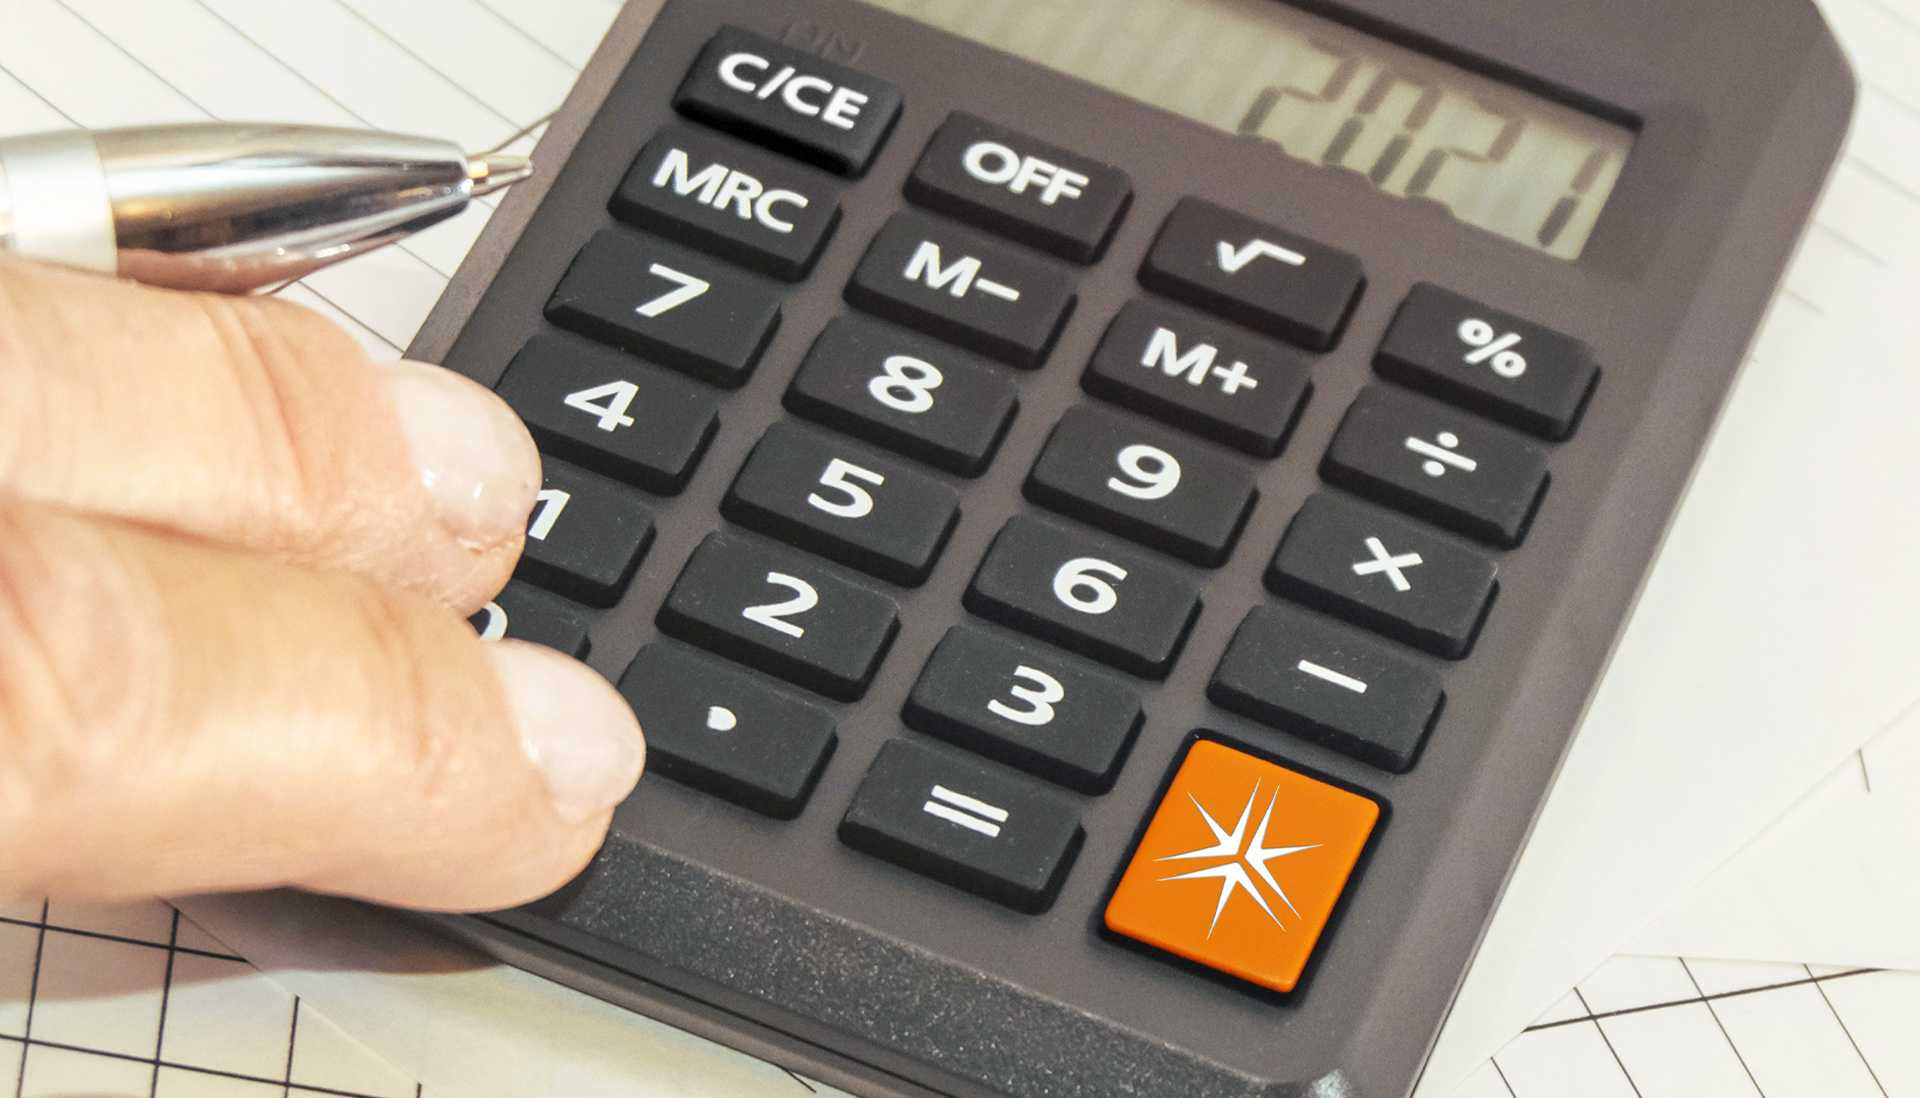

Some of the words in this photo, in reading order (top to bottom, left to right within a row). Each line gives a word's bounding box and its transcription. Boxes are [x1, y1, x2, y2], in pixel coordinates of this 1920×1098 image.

[717, 52, 869, 131] C/CE
[962, 141, 1089, 205] OFF
[1238, 36, 1606, 249] 2021
[651, 148, 809, 233] MRC
[635, 263, 711, 317] 7
[1139, 326, 1258, 395] M+
[1457, 317, 1528, 379] %
[563, 379, 640, 433] 4
[866, 354, 944, 414] 8
[807, 457, 885, 519] 5
[1107, 443, 1182, 501] 9
[527, 489, 571, 541] 1
[741, 571, 819, 639] 2
[1052, 556, 1128, 615] 6
[986, 664, 1065, 726] 3
